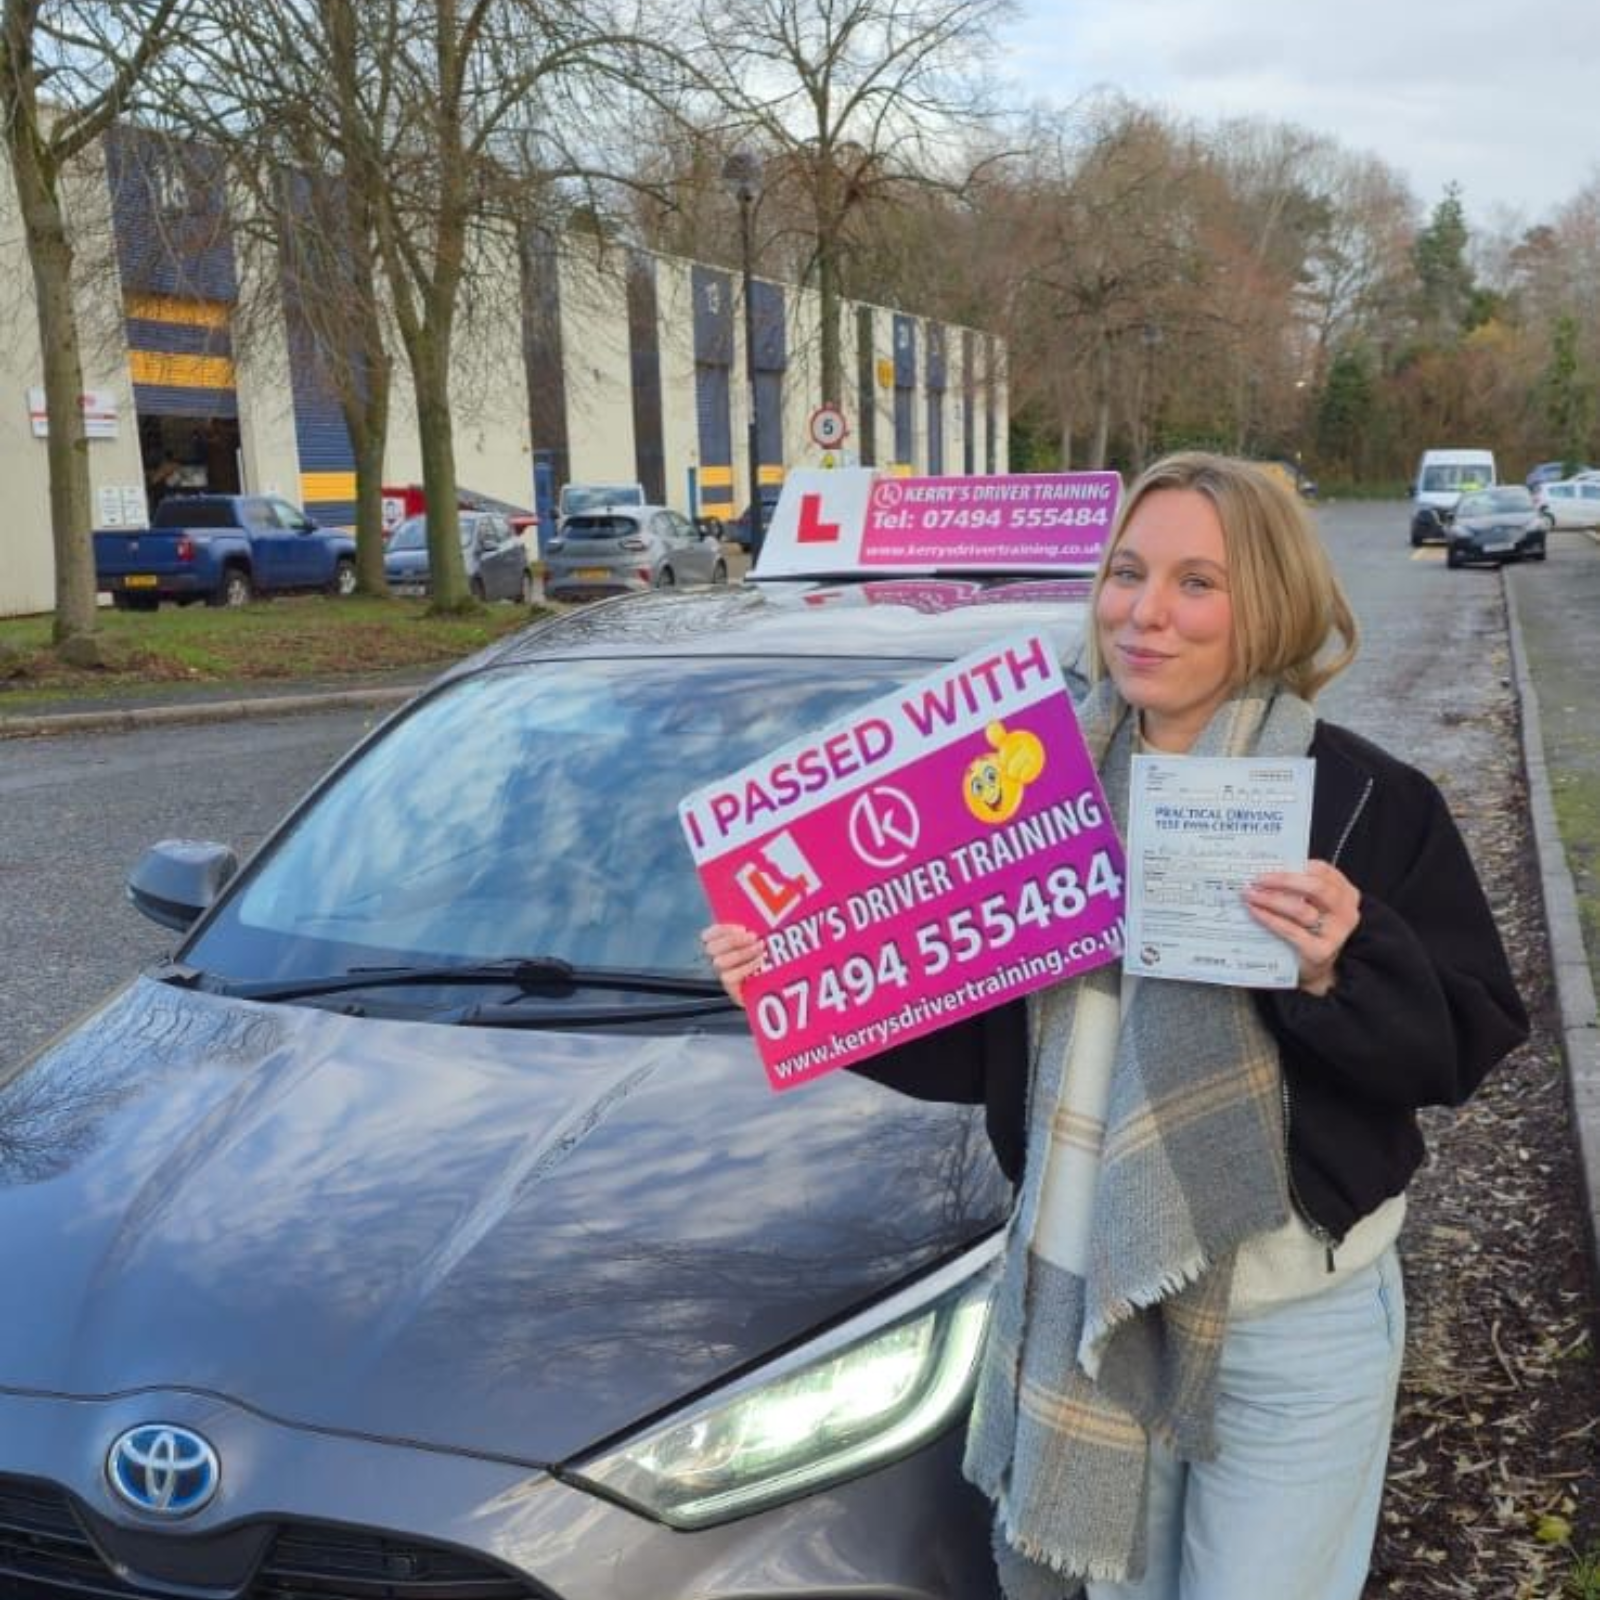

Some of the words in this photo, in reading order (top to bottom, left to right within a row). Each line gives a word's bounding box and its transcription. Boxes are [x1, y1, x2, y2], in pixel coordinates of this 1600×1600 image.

[823, 418, 833, 435] 5
[905, 486, 971, 503] KERRY'S
[974, 484, 1031, 501] DRIVER
[1034, 483, 1111, 500] TRAINING
[797, 493, 839, 543] L
[873, 509, 913, 528] Tel:
[922, 508, 1001, 528] 07494
[1008, 507, 1108, 527] 555484
[686, 811, 705, 848] I
[709, 718, 894, 837] PASSED
[902, 637, 1051, 737] WITH
[1155, 807, 1222, 820] PRACTICAL
[1226, 809, 1284, 821] DRIVING
[756, 907, 847, 974] ERRY'S
[847, 858, 954, 932] DRIVER
[951, 791, 1103, 883] TRAINING
[756, 941, 910, 1041] 07494
[916, 851, 1123, 976] 555484
